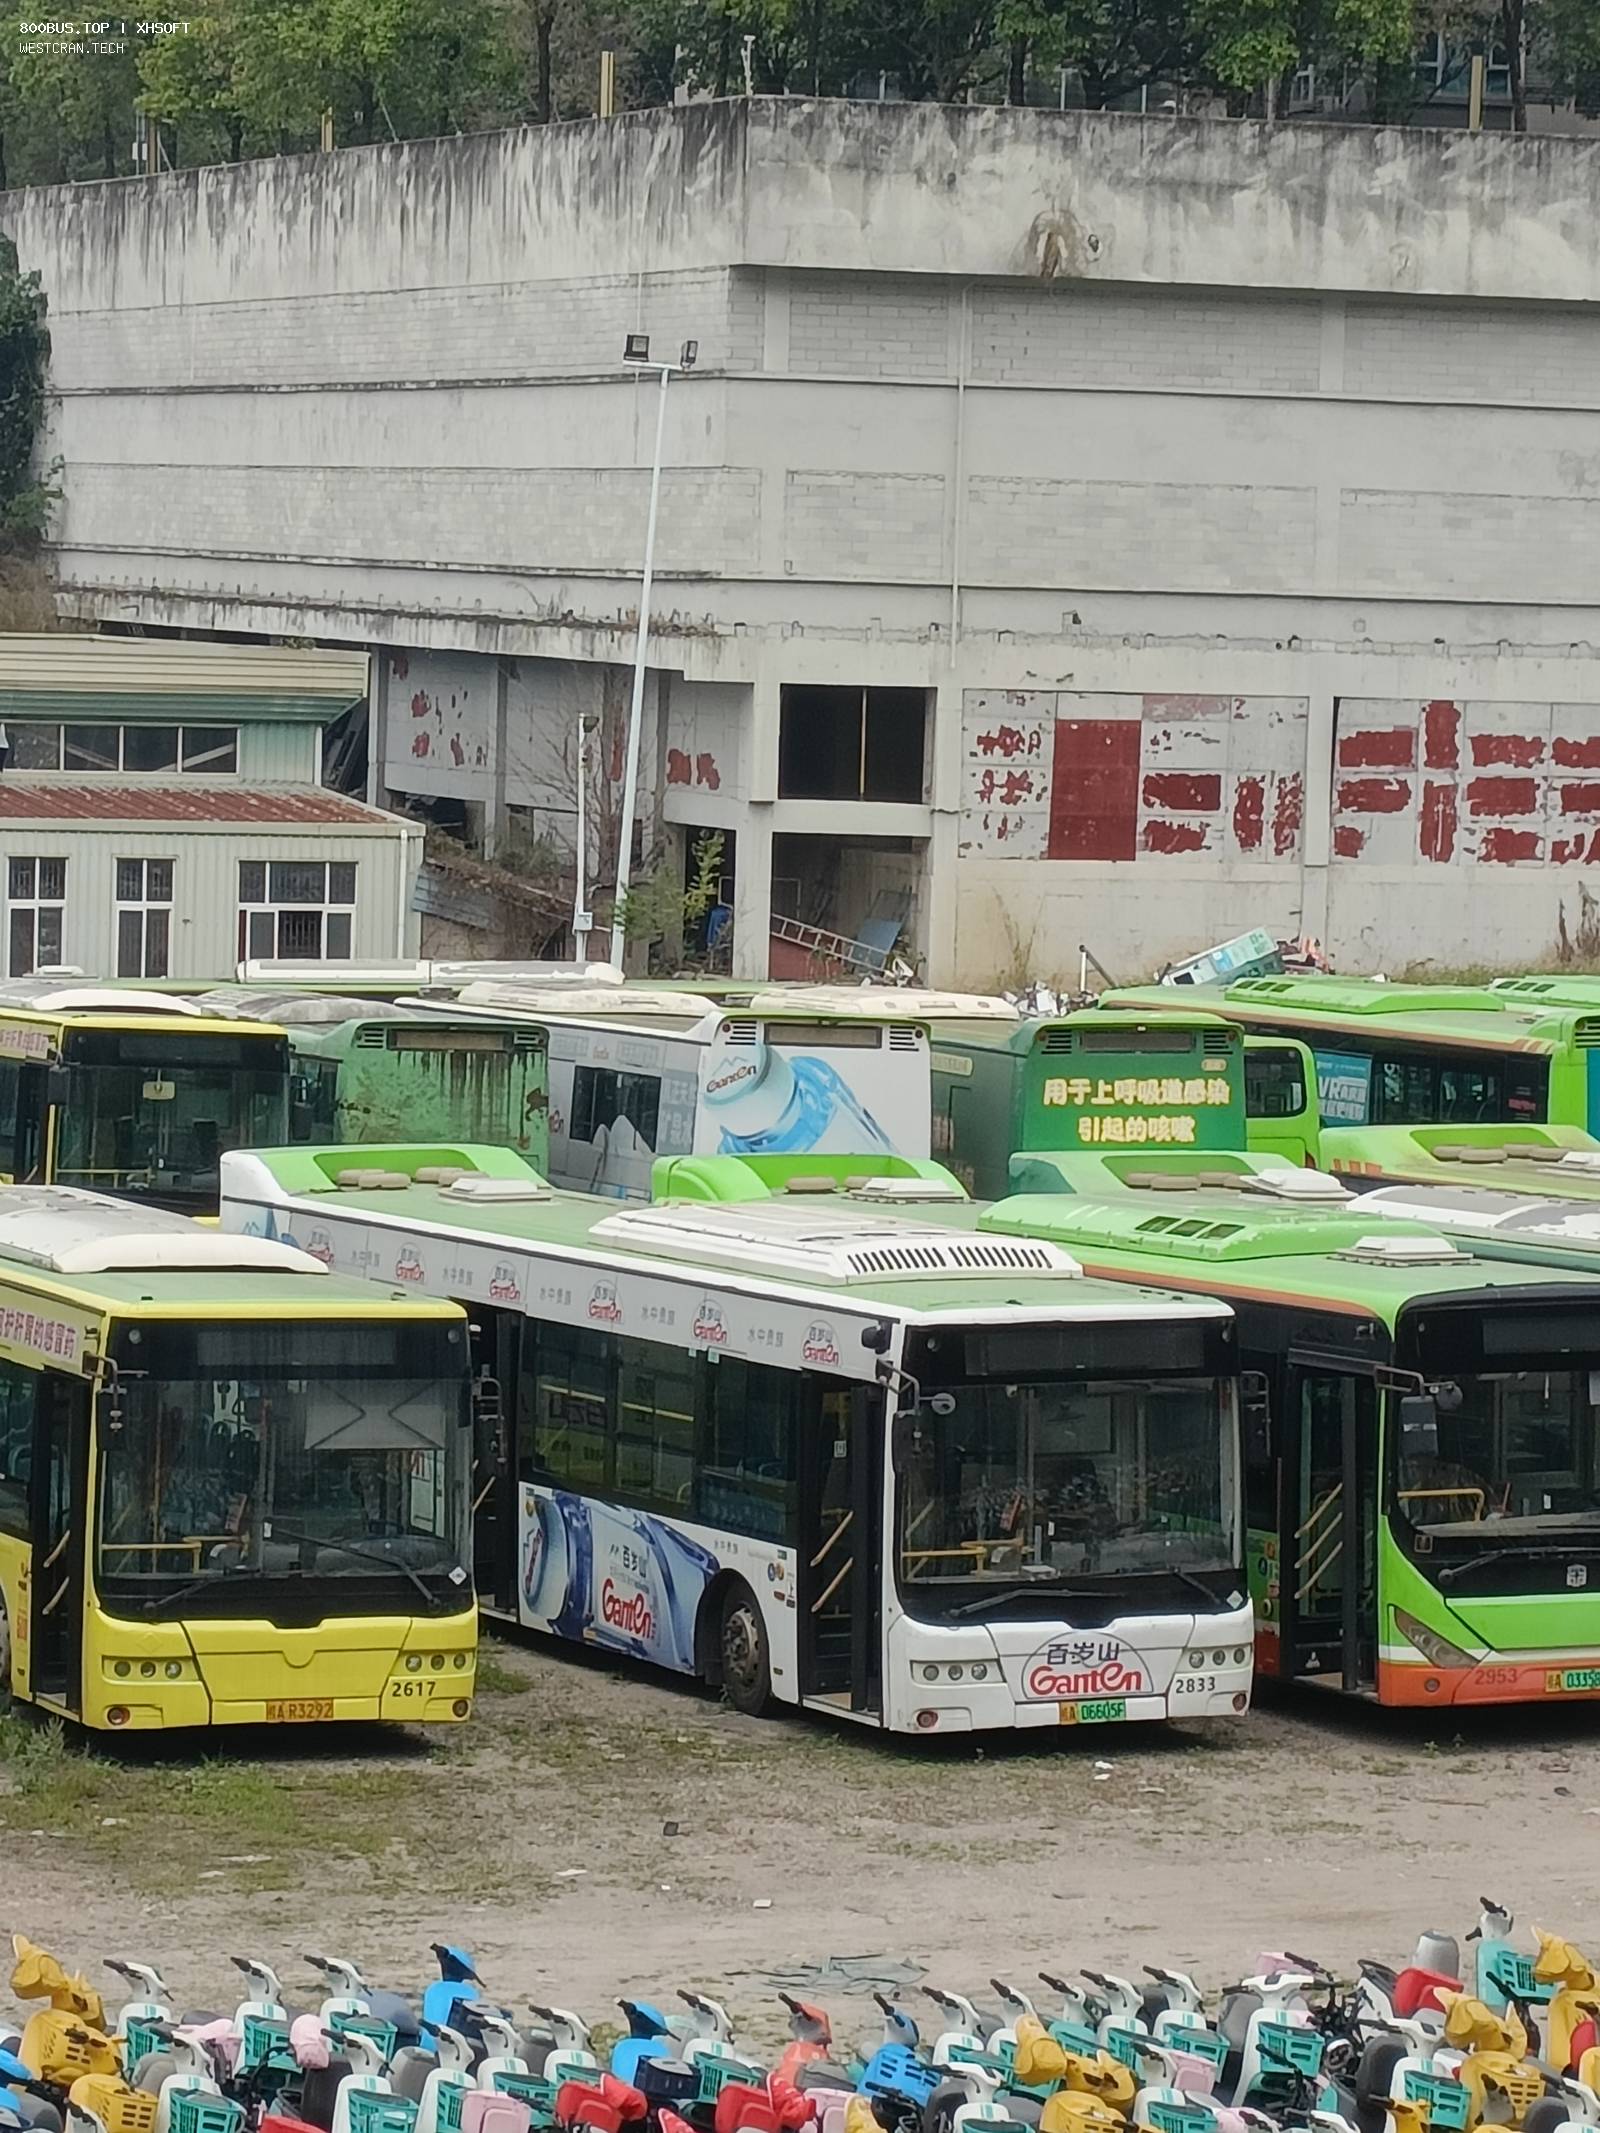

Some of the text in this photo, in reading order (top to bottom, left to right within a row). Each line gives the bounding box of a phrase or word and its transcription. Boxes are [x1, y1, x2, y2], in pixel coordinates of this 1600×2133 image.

[1043, 1078, 1230, 1105] 用于上呼吸道感染
[1078, 1115, 1196, 1142] 引起的咳嗽
[1046, 1641, 1120, 1665] 百岁山
[1175, 1676, 1216, 1694] 2833
[1474, 1667, 1518, 1685] 2953
[391, 1681, 436, 1697] 2617
